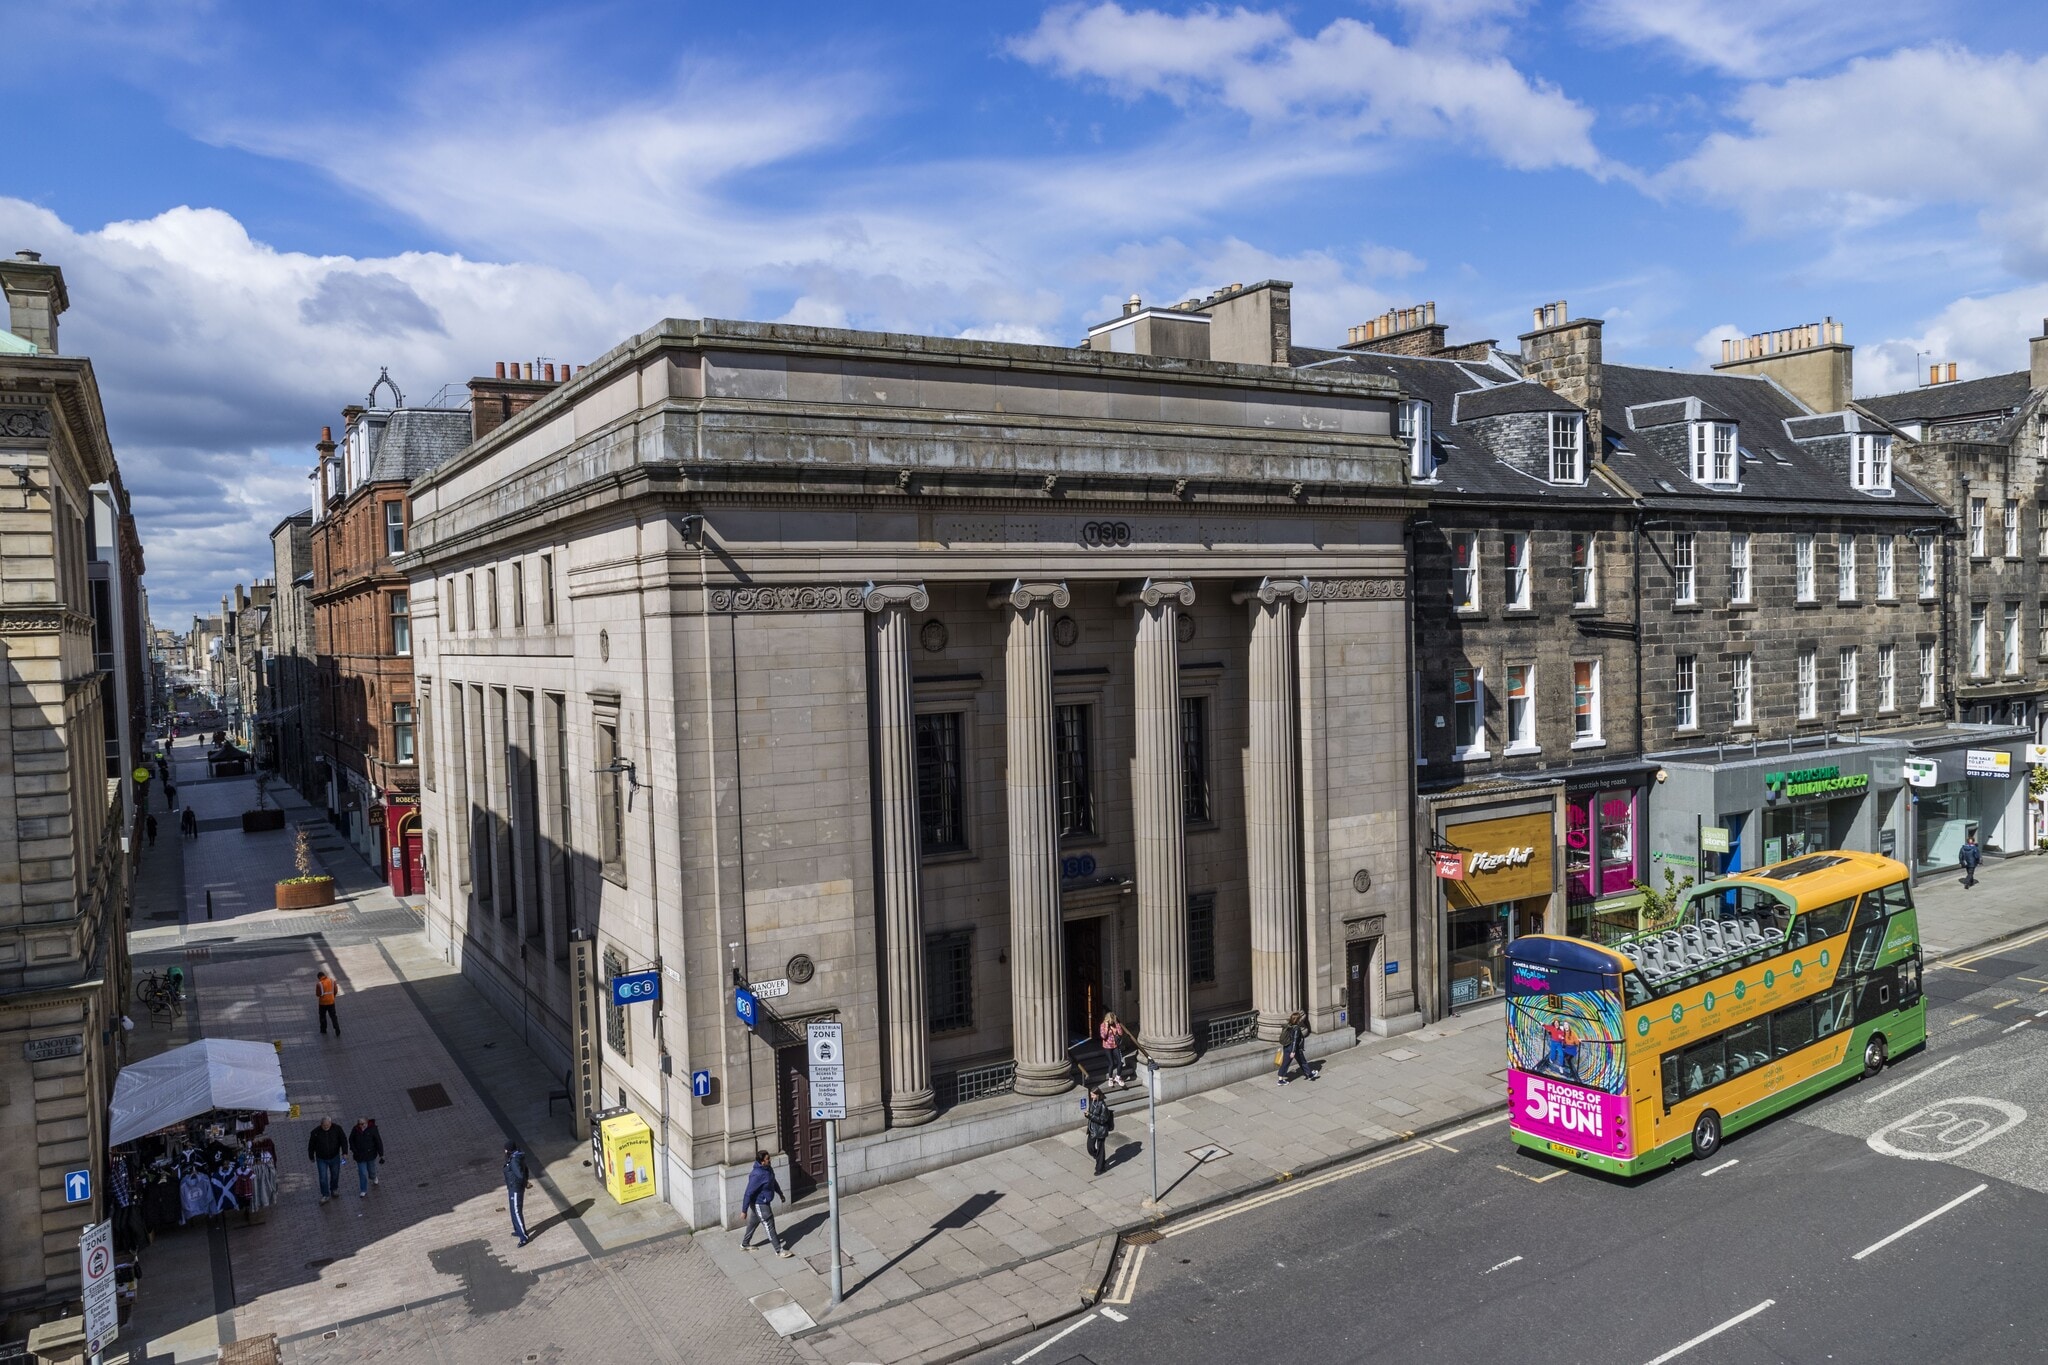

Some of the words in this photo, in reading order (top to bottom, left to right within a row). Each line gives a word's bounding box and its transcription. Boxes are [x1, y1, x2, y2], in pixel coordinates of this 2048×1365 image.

[1087, 525, 1127, 541] TSB
[1787, 766, 1840, 783] YORKSHIRE
[1578, 781, 1600, 790] scottish
[1600, 779, 1611, 788] hog
[1610, 778, 1627, 786] roasts
[1704, 831, 1726, 840] Health
[1704, 838, 1726, 847] store
[1438, 854, 1460, 865] Pizza
[1469, 852, 1506, 873] Pizza
[1504, 847, 1534, 866] Hut
[1441, 866, 1457, 875] Hut
[1887, 935, 1913, 949] EDINBURGH
[1512, 961, 1529, 969] CAMERA
[1528, 964, 1549, 973] OBSCURA
[576, 955, 588, 1008] ROSE
[29, 1037, 77, 1051] HANOVER
[35, 1045, 73, 1059] STREET
[580, 1028, 593, 1119] STREET
[1525, 1077, 1548, 1120] 5
[1547, 1082, 1585, 1101] FLOORS
[1586, 1093, 1602, 1105] OF
[1547, 1092, 1602, 1114] INTERACTIVE
[1548, 1101, 1603, 1138] FUN!
[1899, 1111, 1991, 1144] 20
[82, 1224, 110, 1243] PEDESTRIAN
[86, 1233, 107, 1251] ZONE
[89, 1280, 104, 1294] Except
[90, 1301, 105, 1314] Except
[93, 1305, 109, 1319] loading
